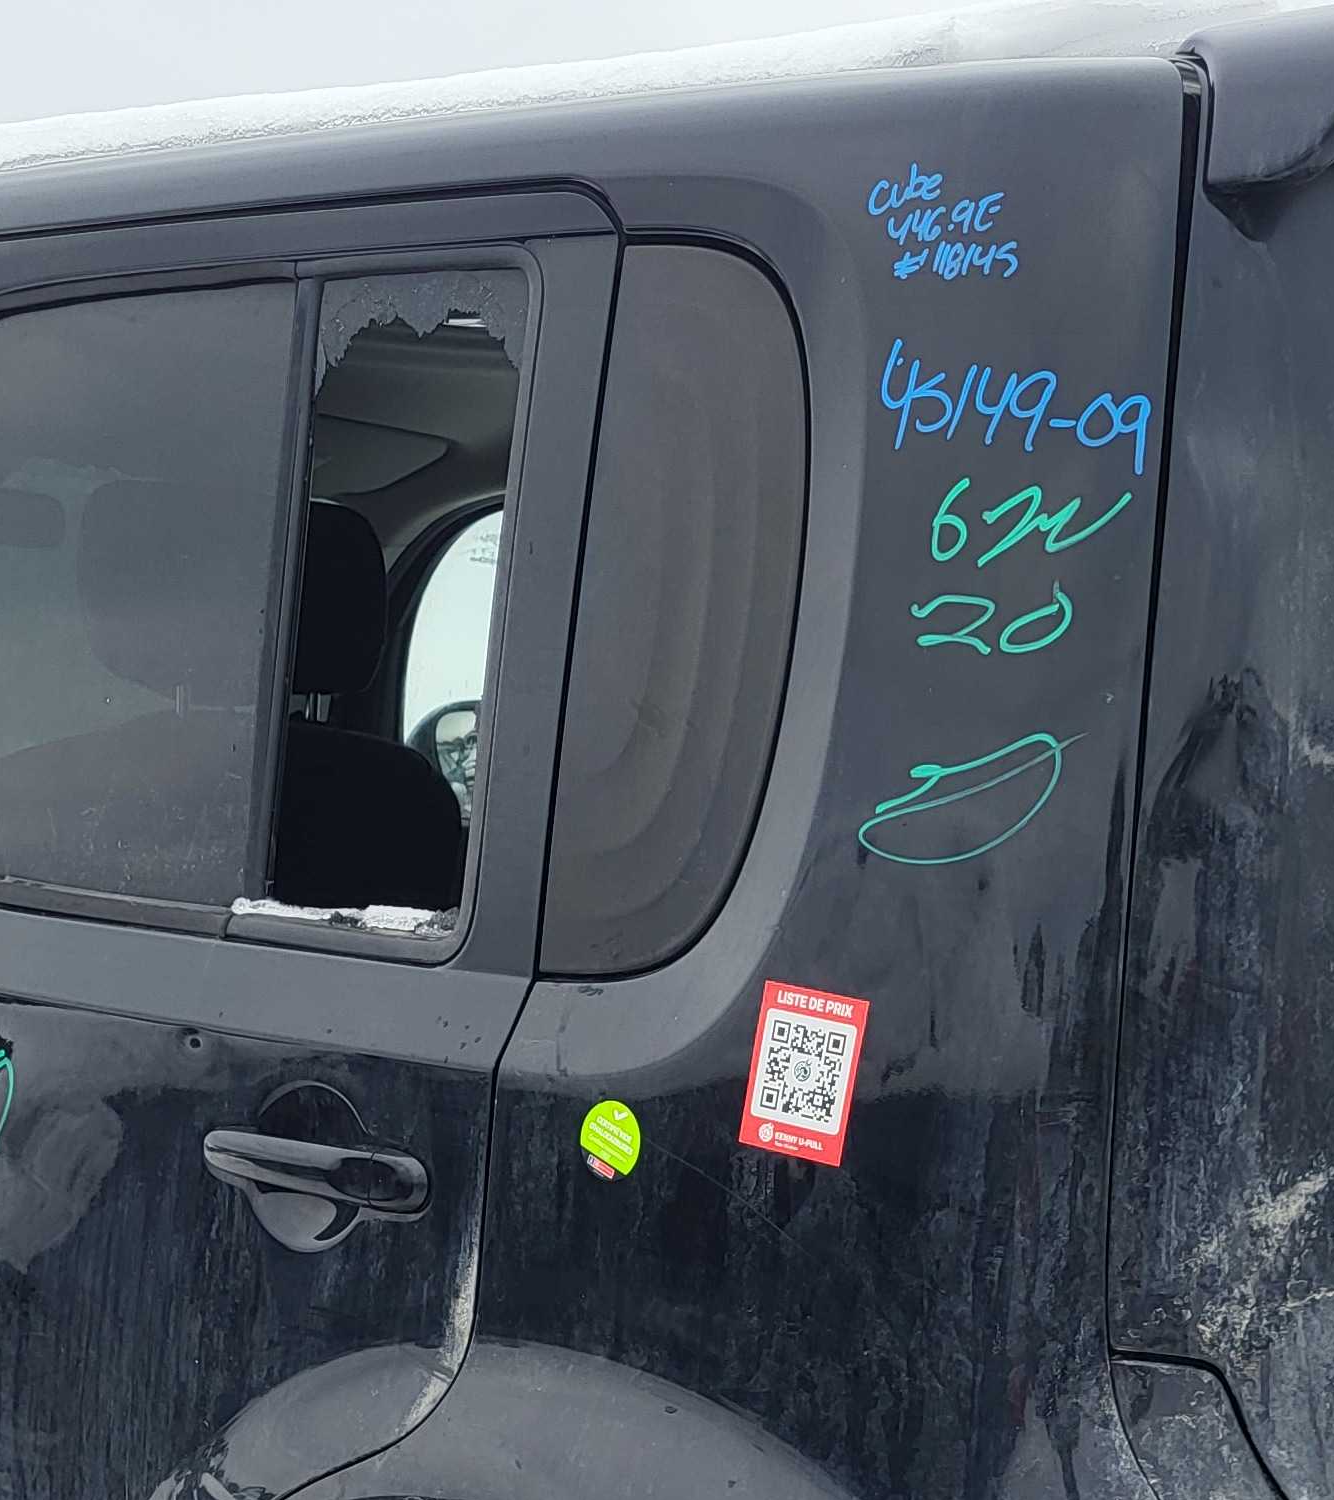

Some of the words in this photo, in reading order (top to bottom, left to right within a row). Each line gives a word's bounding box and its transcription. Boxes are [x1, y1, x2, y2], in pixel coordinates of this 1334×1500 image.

[880, 337, 1152, 476] 45149-09
[776, 989, 808, 1008] LISTE
[808, 996, 826, 1013] DE
[825, 1000, 855, 1019] PRIX
